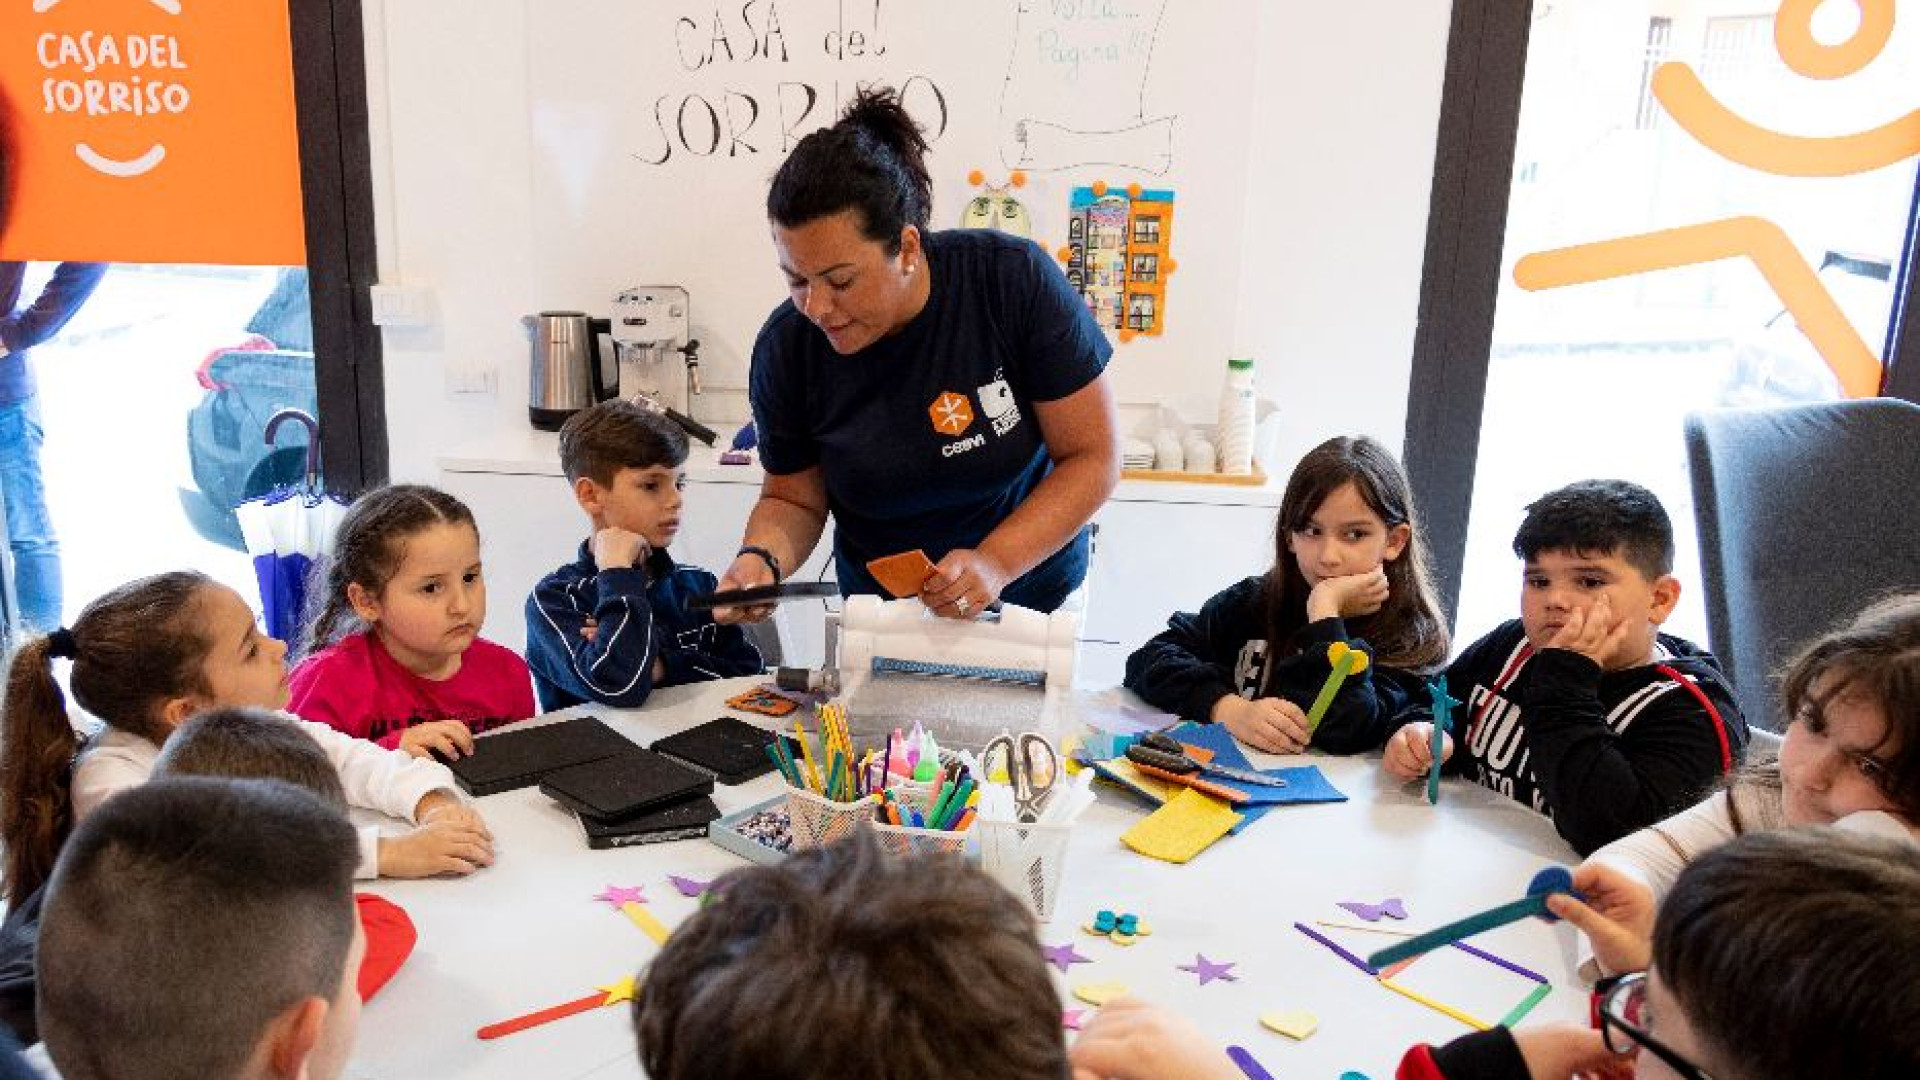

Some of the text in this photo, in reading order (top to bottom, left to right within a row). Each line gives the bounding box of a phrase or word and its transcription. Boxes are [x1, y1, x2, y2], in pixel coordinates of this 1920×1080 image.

[37, 30, 188, 73] CASA DEL
[675, 0, 886, 71] CASA del
[631, 75, 948, 165] SORRIO
